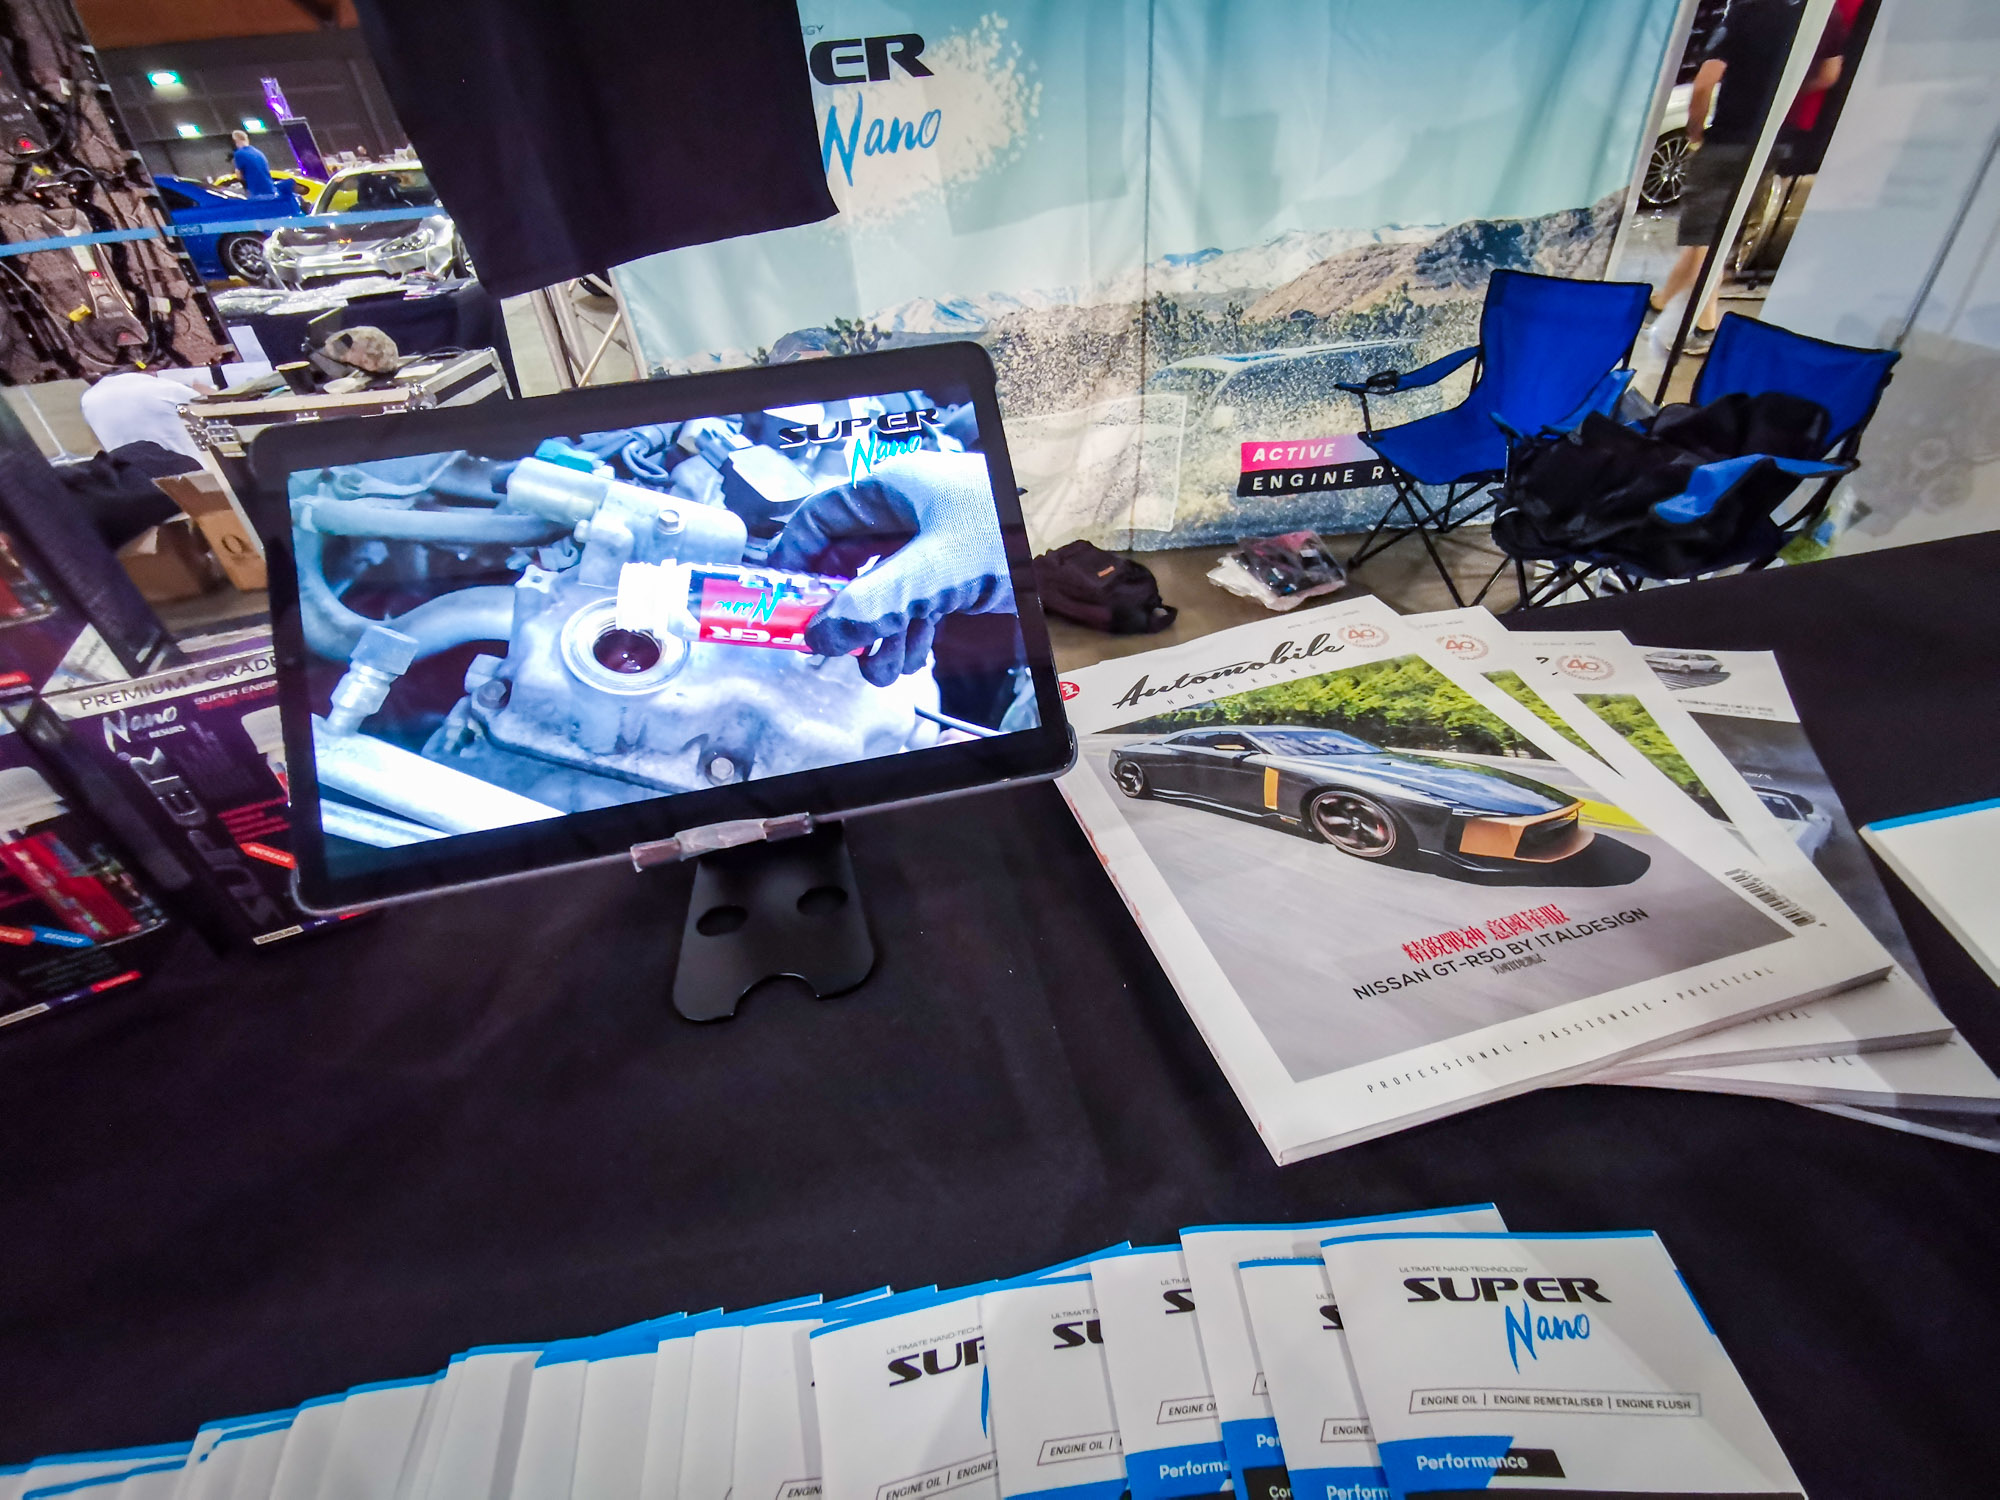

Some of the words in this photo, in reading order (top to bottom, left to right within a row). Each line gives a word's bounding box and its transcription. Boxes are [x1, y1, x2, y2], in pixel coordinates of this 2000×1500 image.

[822, 90, 941, 187] Nano
[778, 408, 946, 448] SUPER
[851, 431, 922, 489] Nano
[1252, 443, 1336, 462] ACTIVE
[1252, 469, 1355, 490] ENGINE
[1112, 633, 1344, 709] Automobile
[80, 675, 189, 710] PREMIUM
[102, 706, 178, 753] Nano
[1352, 968, 1433, 1000] NISSAN
[1433, 947, 1506, 977] GT-R50
[1506, 938, 1534, 956] BY
[1534, 907, 1650, 948] ITALDESIGN
[1367, 1043, 1513, 1093] PROFESSIONAL
[1539, 1001, 1652, 1042] PASSIONATE
[1677, 966, 1776, 1000] PRACTICAL
[1403, 1277, 1612, 1303] SUPER
[1504, 1298, 1590, 1374] Nano
[1169, 1403, 1204, 1416] ENGINE
[1421, 1396, 1458, 1406] ENGINE
[1462, 1395, 1477, 1405] OIL
[1494, 1395, 1531, 1406] ENGINE
[1534, 1397, 1603, 1408] REMETALISER
[1616, 1398, 1654, 1410] ENGINE
[1657, 1400, 1691, 1410] FLUSH
[1050, 1442, 1086, 1456] ENGINE
[1088, 1440, 1104, 1450] OIL
[1333, 1426, 1369, 1436] ENGINE
[886, 1484, 923, 1500] ENGINE
[926, 1476, 941, 1489] OIL
[957, 1460, 993, 1479] ENGINE
[1417, 1453, 1529, 1471] Performance
